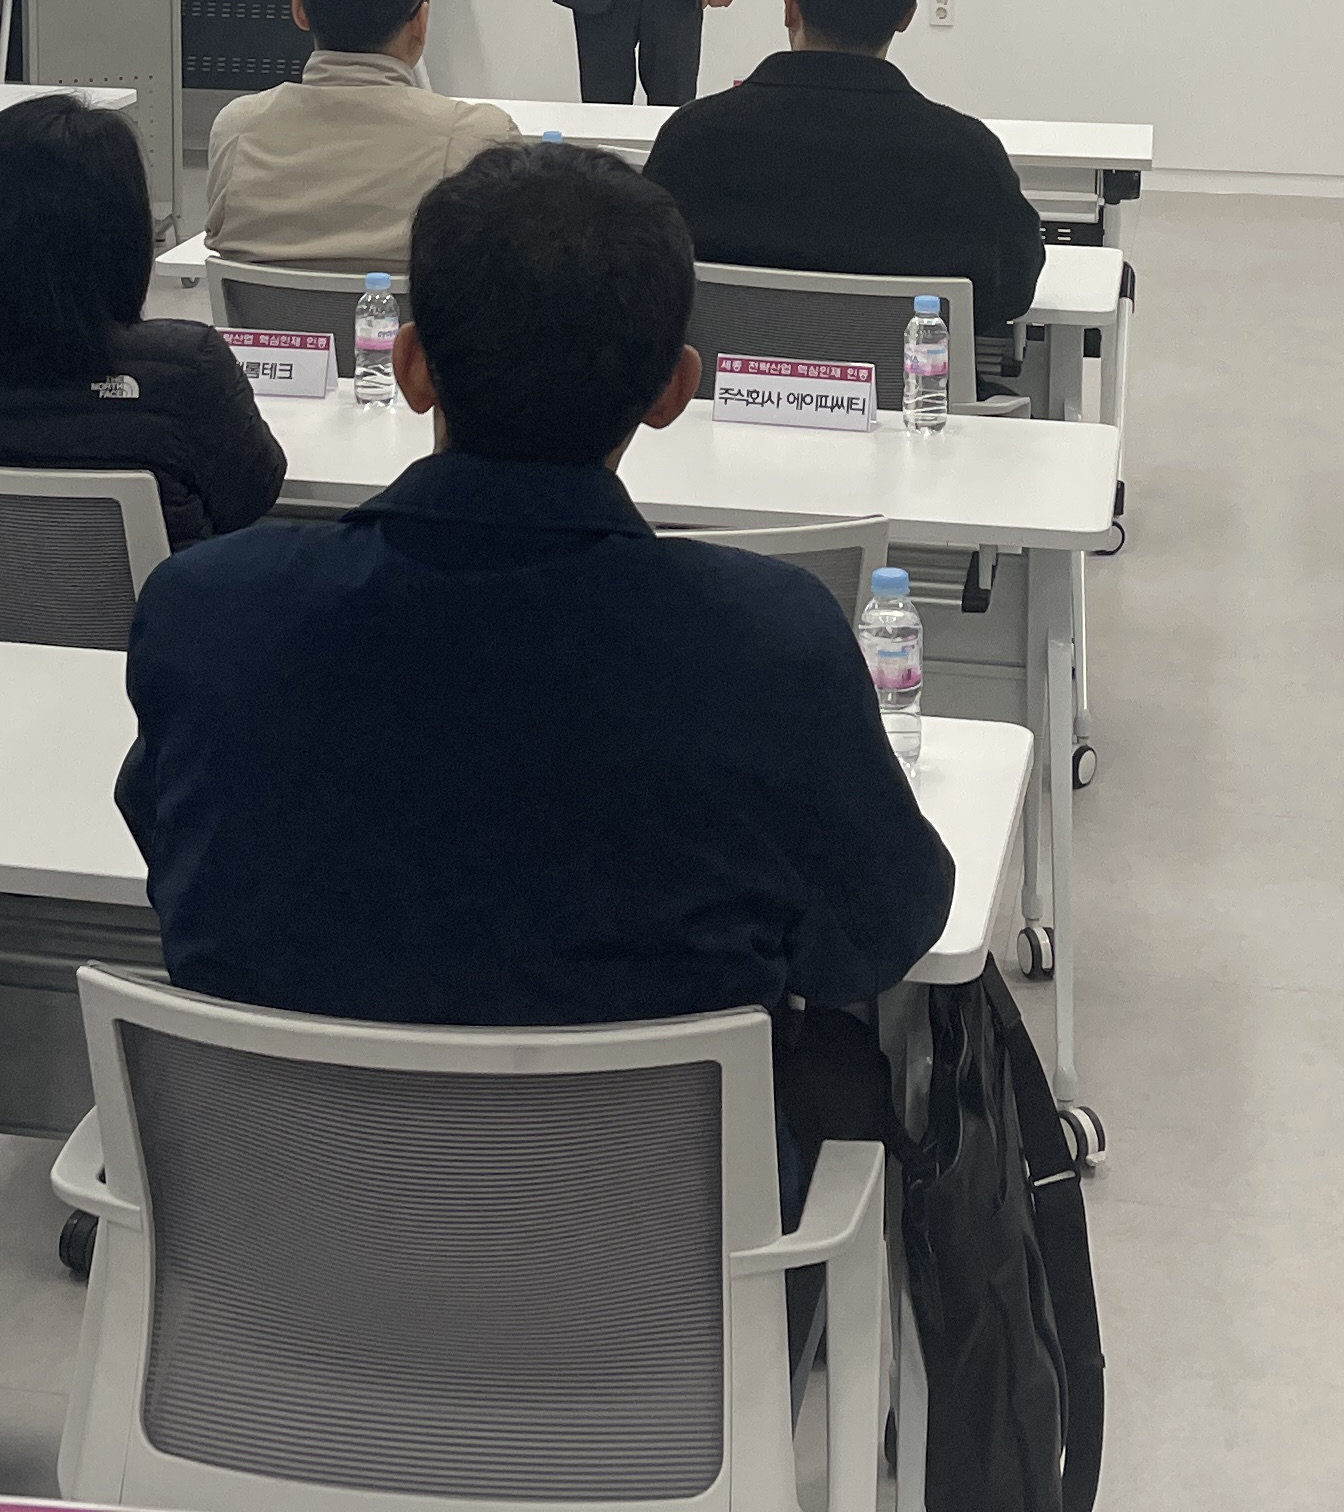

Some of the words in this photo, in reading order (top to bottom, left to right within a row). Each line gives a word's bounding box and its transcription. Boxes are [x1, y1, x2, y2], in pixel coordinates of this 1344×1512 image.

[748, 361, 792, 375] 전략산업
[797, 364, 841, 378] 핵심인재
[718, 387, 782, 409] 주식회사
